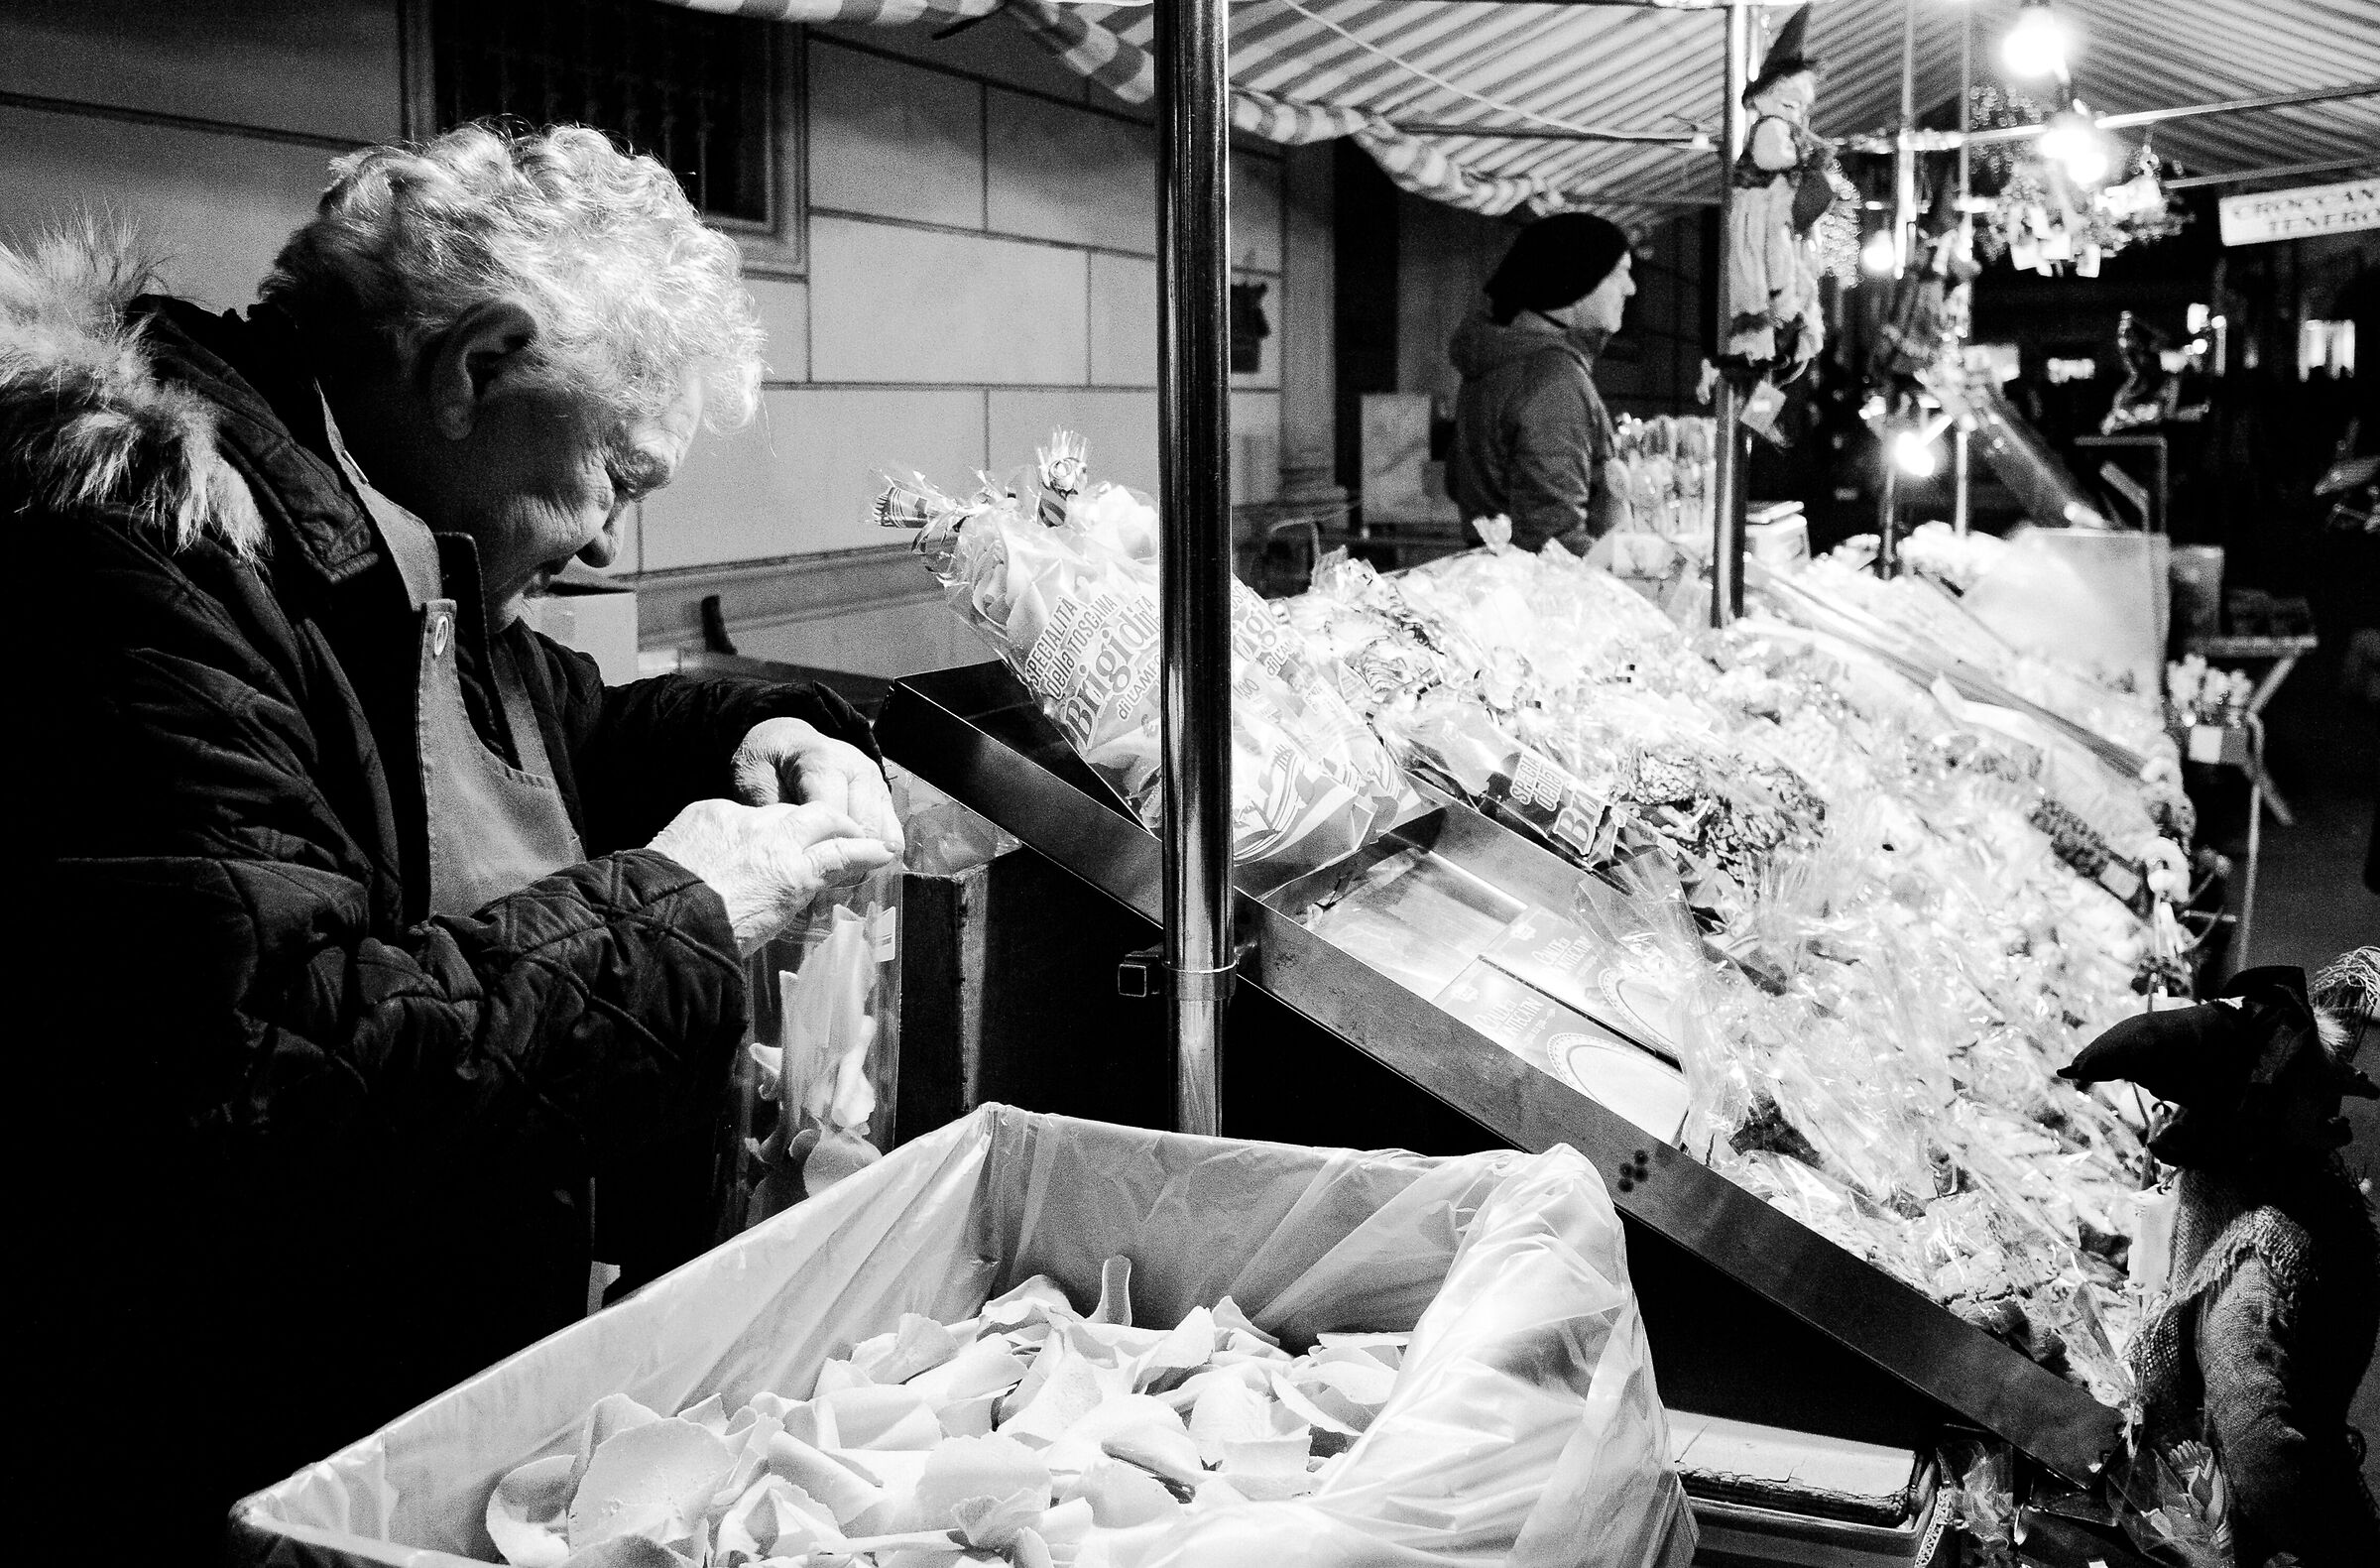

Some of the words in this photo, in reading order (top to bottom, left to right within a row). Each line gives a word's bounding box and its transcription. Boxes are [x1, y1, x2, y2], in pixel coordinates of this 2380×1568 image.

[1025, 596, 1078, 687] SPECIALITÀ
[1045, 651, 1075, 698] della
[1067, 594, 1118, 656] TOSCANA
[1119, 695, 1133, 720] di
